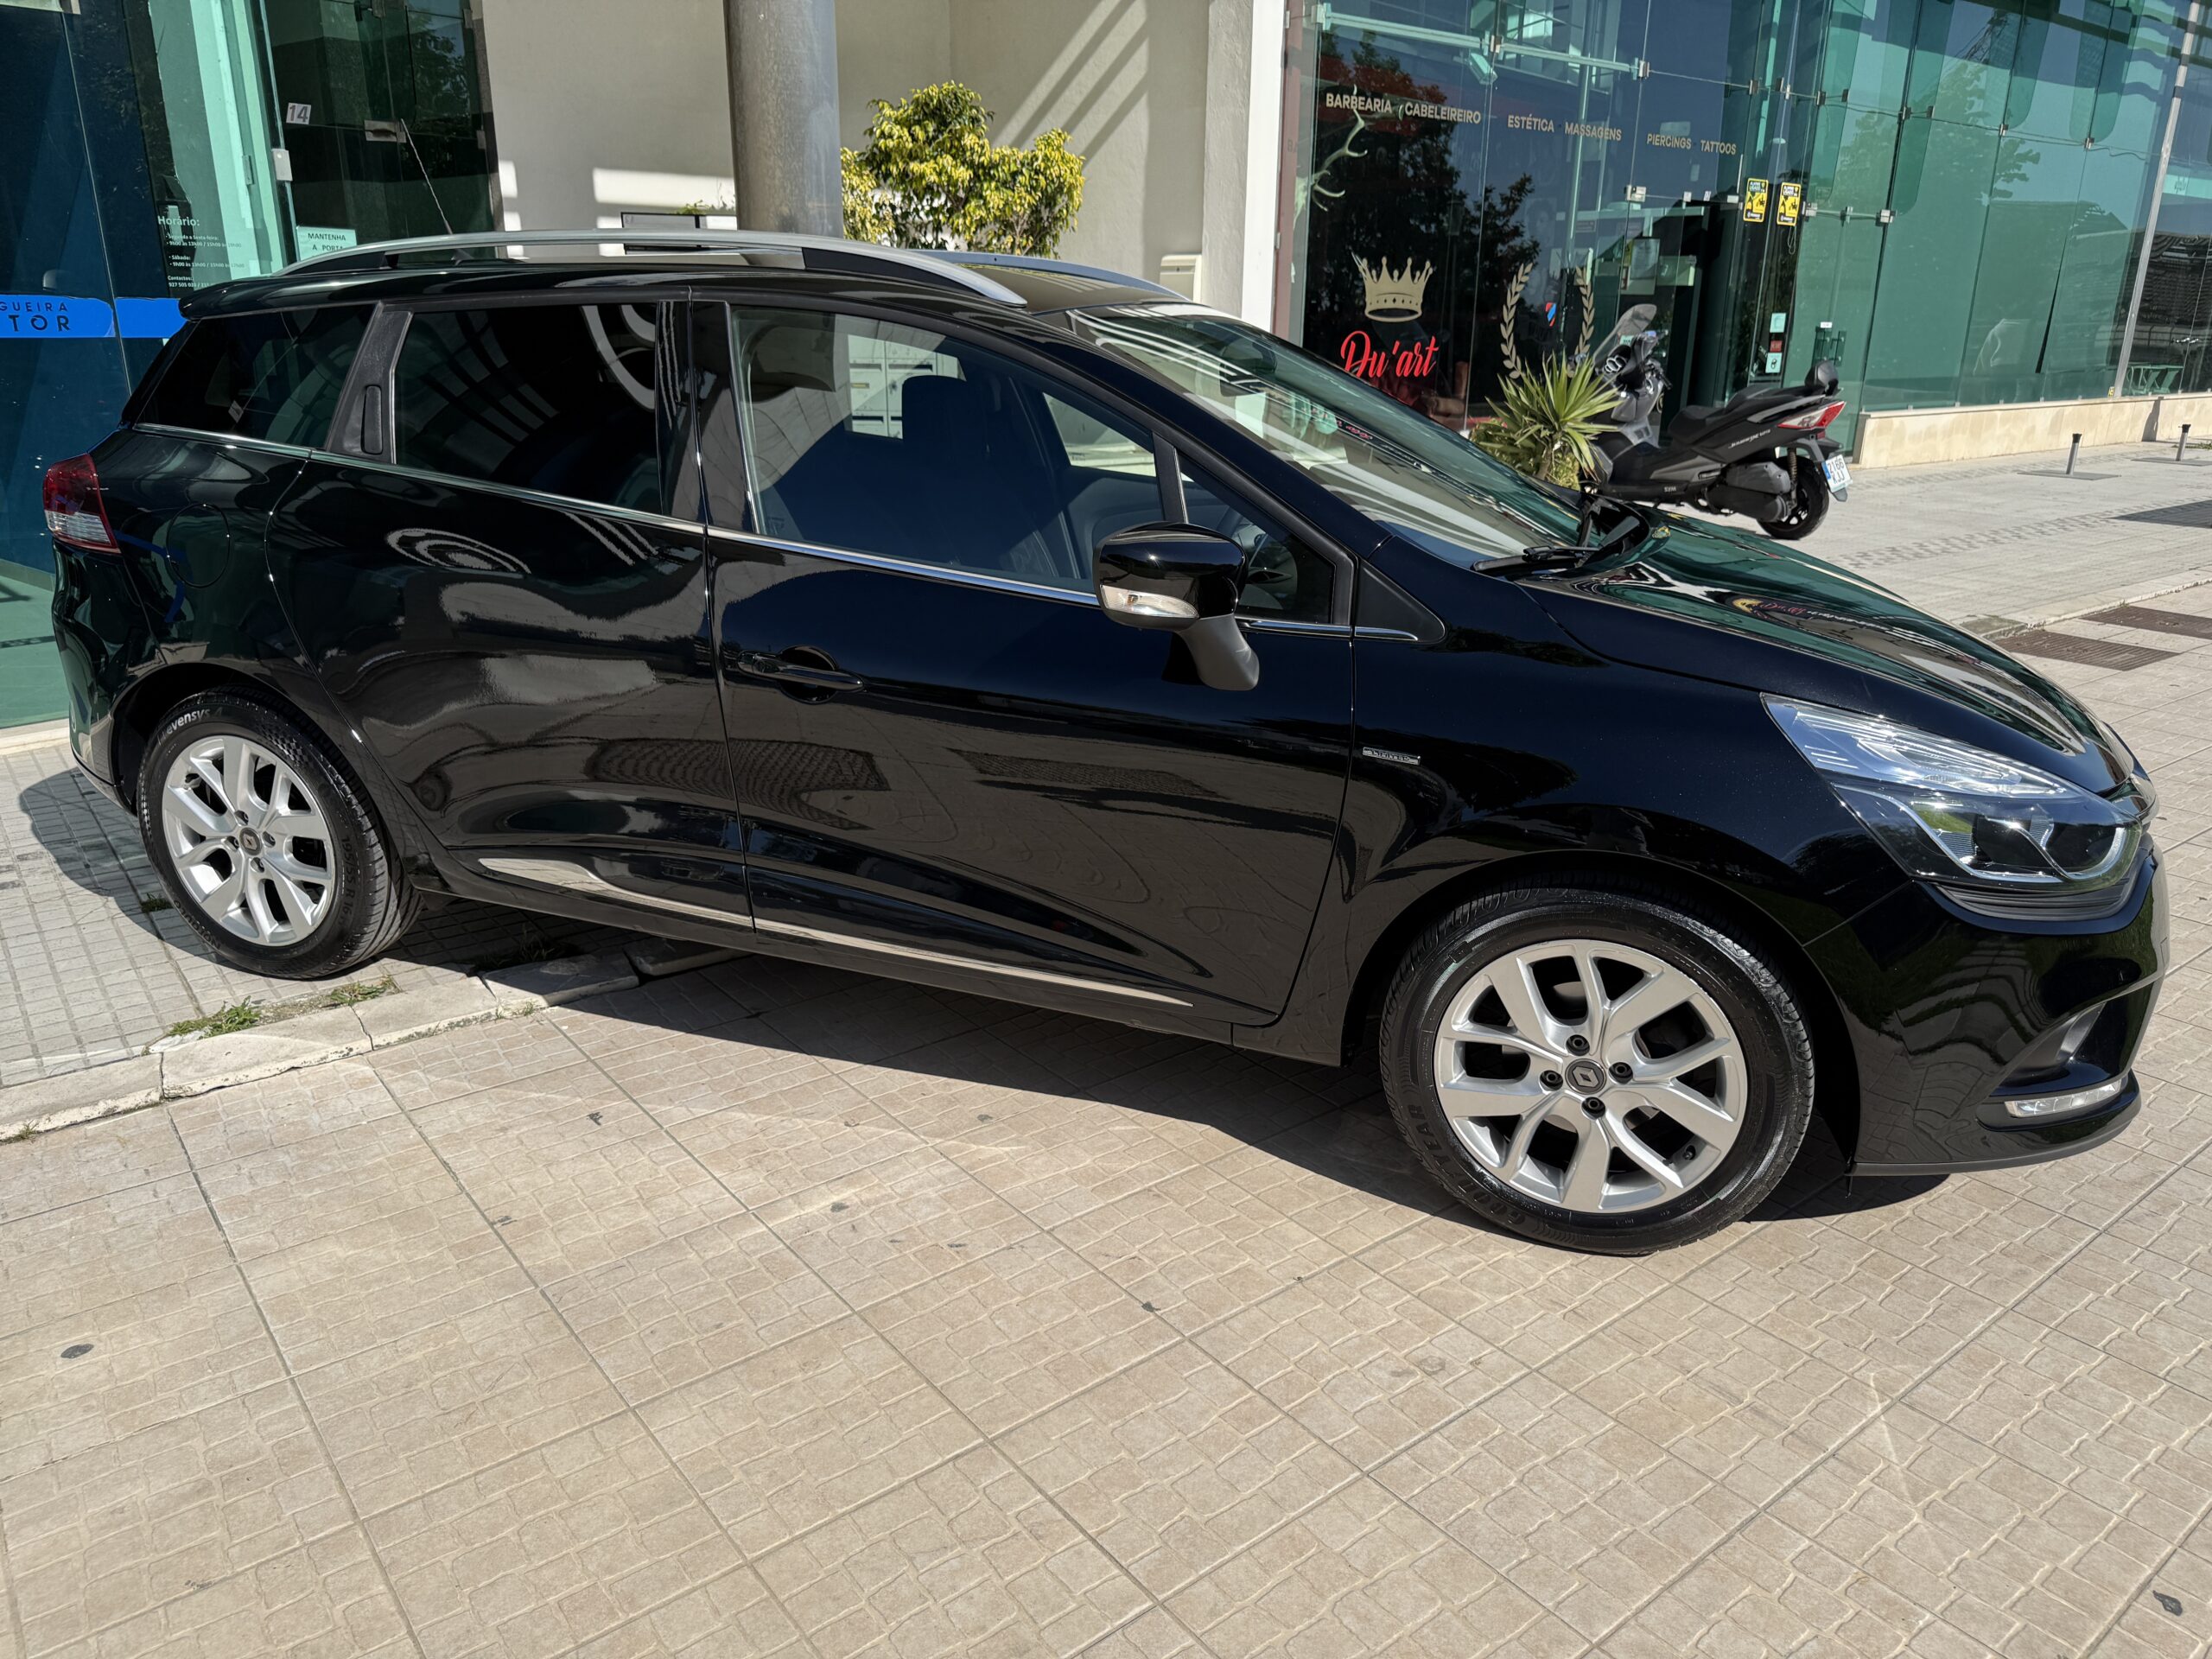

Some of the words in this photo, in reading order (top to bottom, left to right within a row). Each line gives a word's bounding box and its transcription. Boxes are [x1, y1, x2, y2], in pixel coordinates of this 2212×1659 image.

[289, 105, 308, 123] 14
[1326, 93, 1392, 113] BARBEARIA
[1405, 102, 1482, 124] CABELEIREIRO
[1508, 114, 1554, 133] ESTÉTICA
[1565, 122, 1622, 141] MASSAGENS
[1647, 133, 1692, 149] PIERCINGS
[1700, 140, 1737, 155] TATTOOS
[157, 215, 200, 226] Horário:
[308, 232, 346, 241] MANTENHA
[8, 315, 71, 332] TOR
[1340, 330, 1440, 378] Du'art
[1408, 1104, 1527, 1225] GOODYEAR
